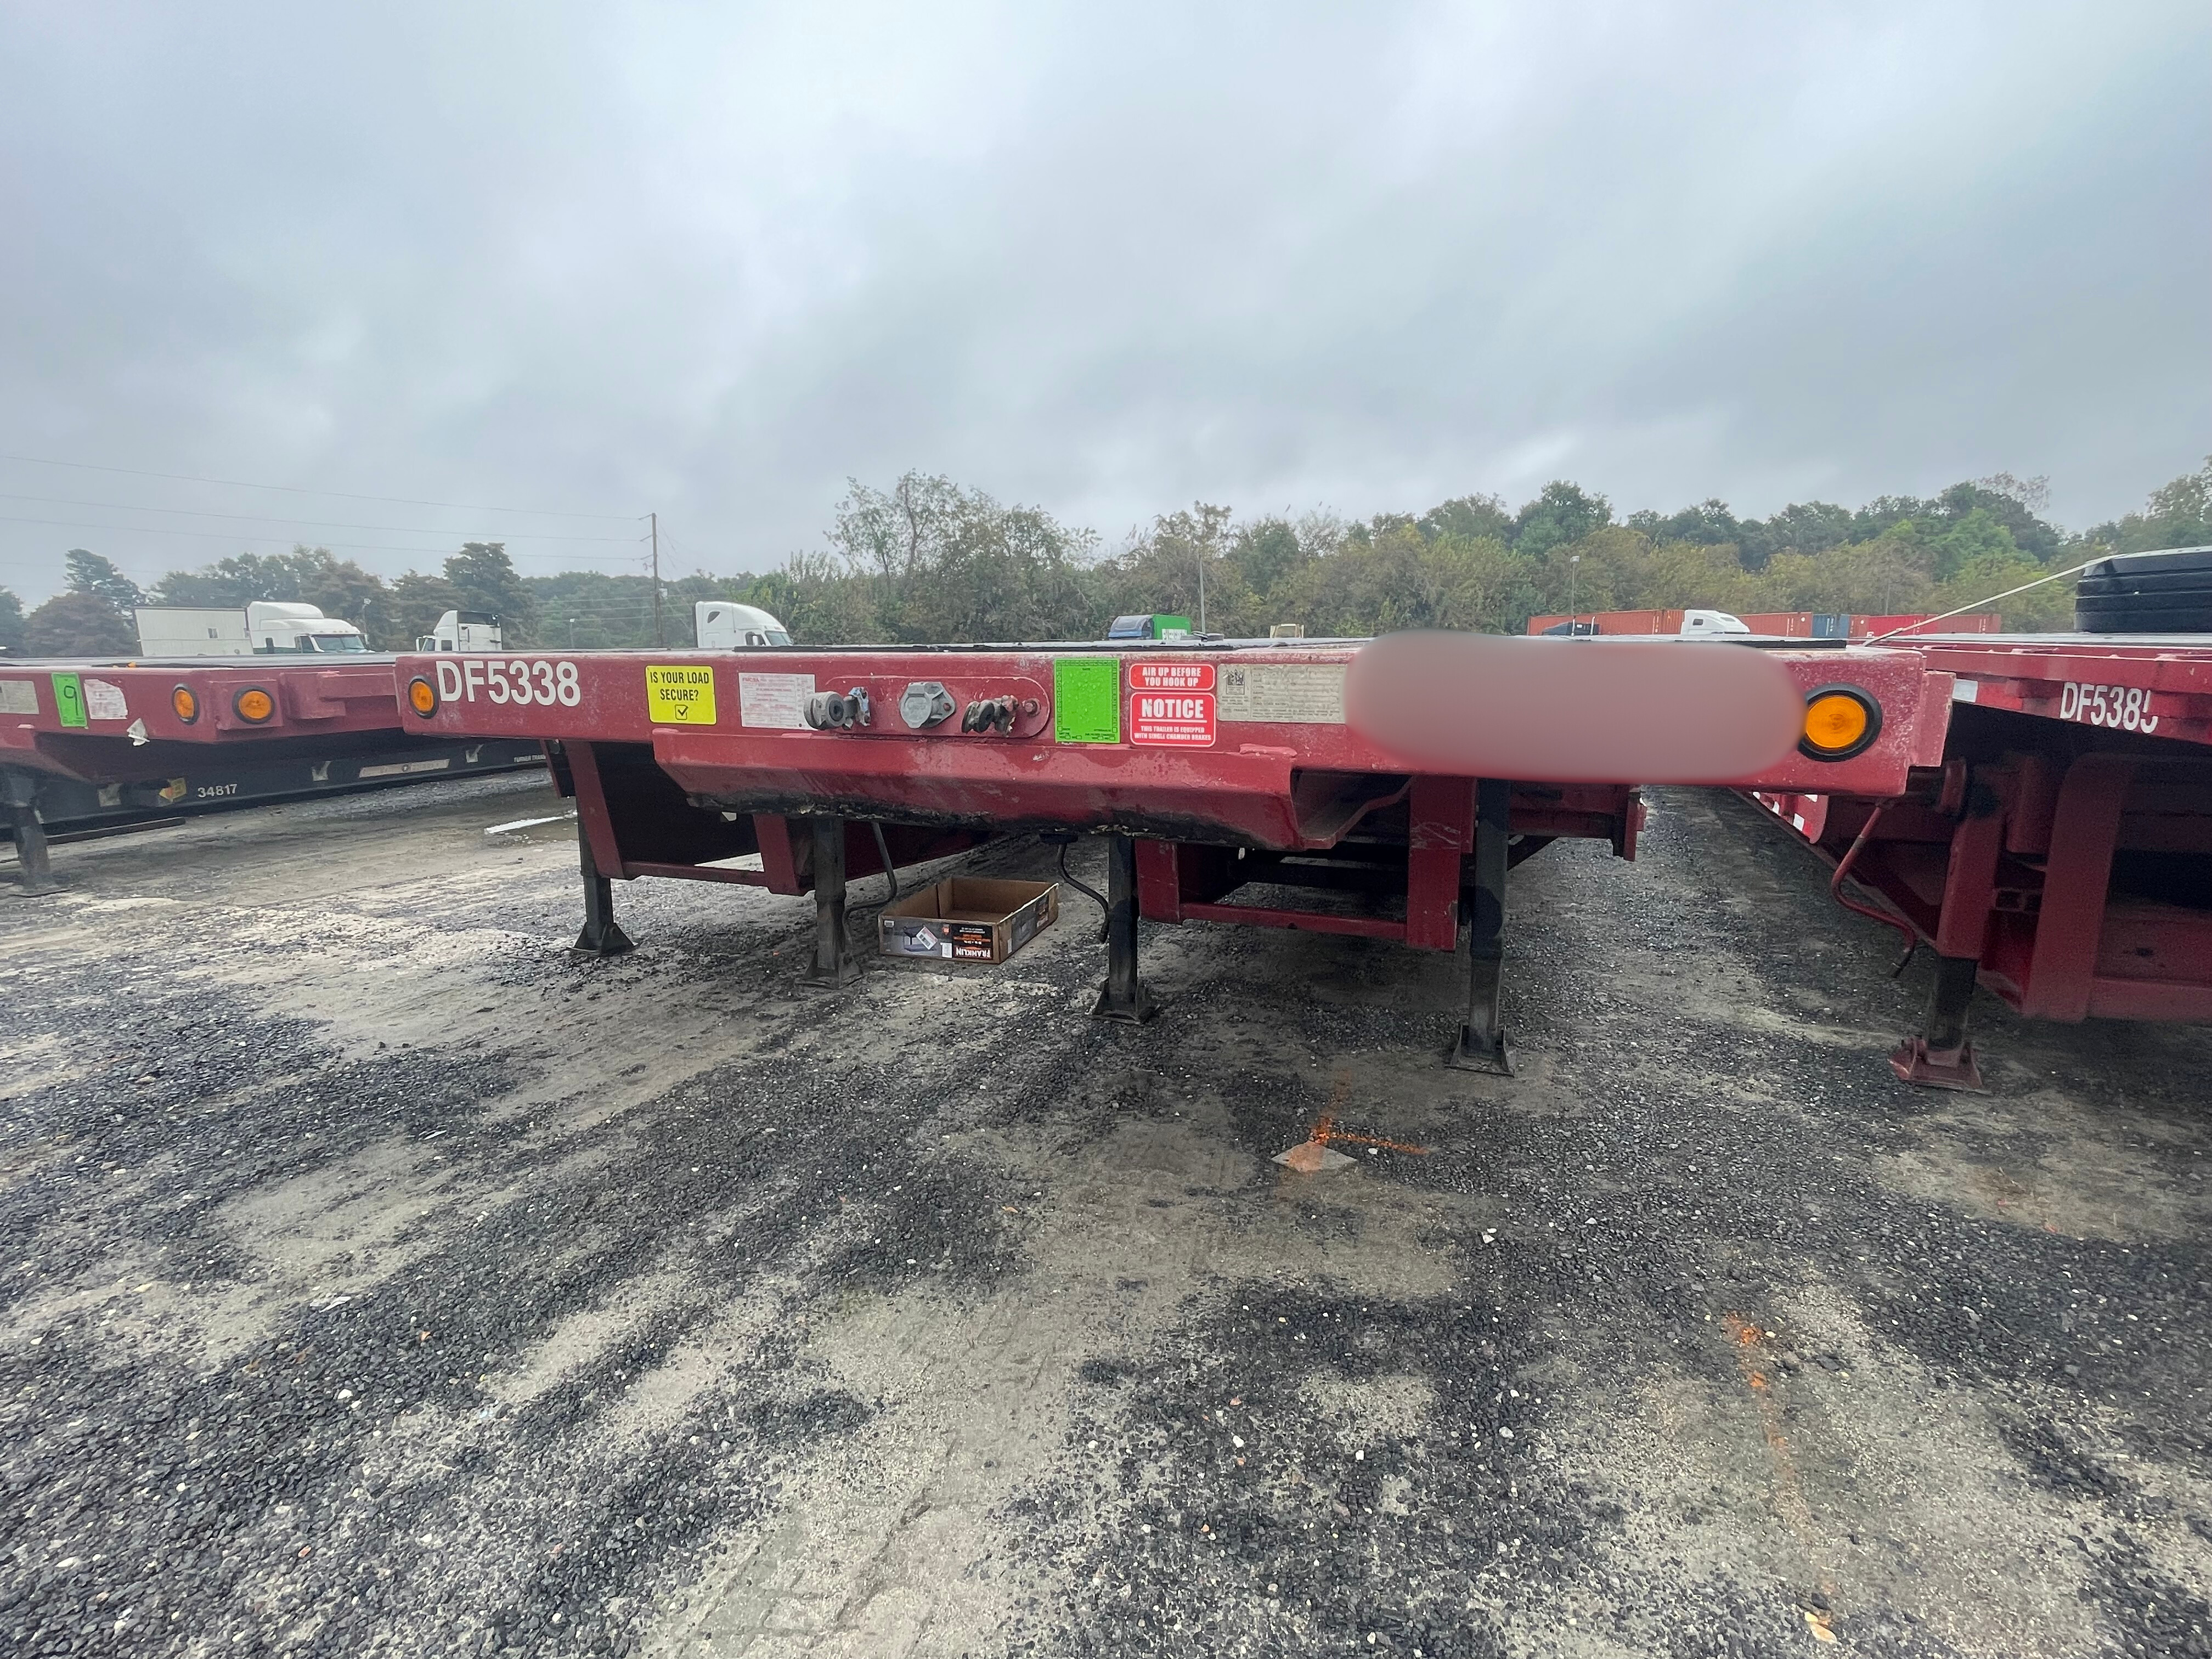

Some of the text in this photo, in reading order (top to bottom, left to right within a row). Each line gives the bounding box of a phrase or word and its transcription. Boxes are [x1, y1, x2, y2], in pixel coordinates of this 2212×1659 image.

[650, 672, 709, 684] IS YOUR LOAD
[1142, 667, 1201, 677] AIR UP BEFORE
[436, 660, 581, 707] DF5338
[1144, 677, 1199, 687] YOU HOOK UP
[660, 689, 699, 701] SECURE?
[1142, 698, 1204, 719] NOTICE
[198, 783, 238, 798] 34817
[956, 946, 991, 958] FRANKLIN
